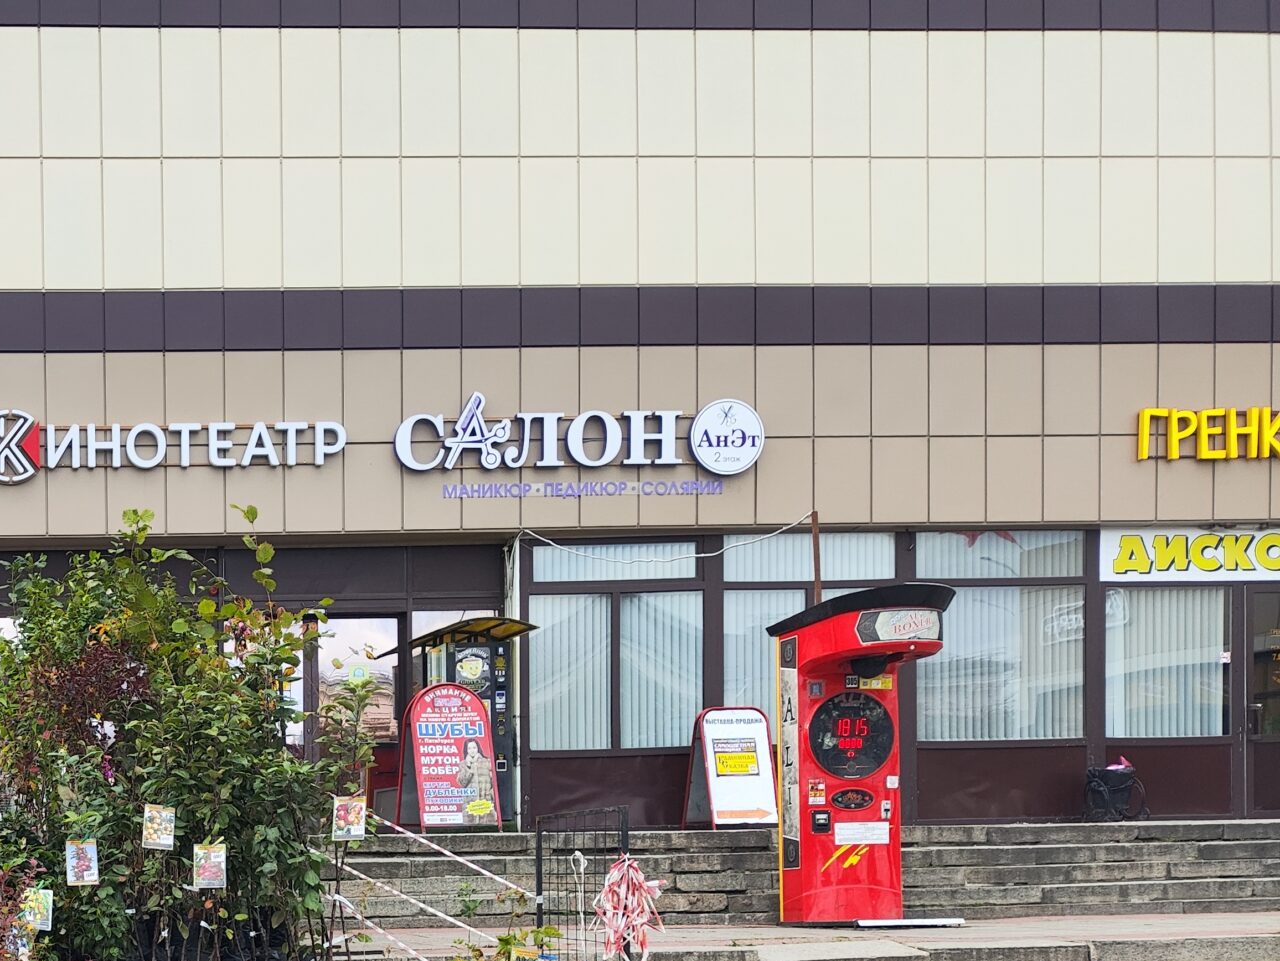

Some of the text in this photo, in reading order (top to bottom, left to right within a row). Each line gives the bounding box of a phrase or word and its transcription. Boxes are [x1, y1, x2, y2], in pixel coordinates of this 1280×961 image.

[394, 391, 683, 472] САЛОН
[697, 428, 760, 448] АнЭт
[714, 451, 721, 463] 2
[442, 483, 532, 498] МАНИКЮР
[543, 481, 627, 499] ПЕДИКЮР
[417, 722, 484, 737] ШУБЫ
[420, 745, 458, 753] НОРКА
[421, 756, 460, 764] МУТОН
[422, 765, 460, 774] БОБЁР
